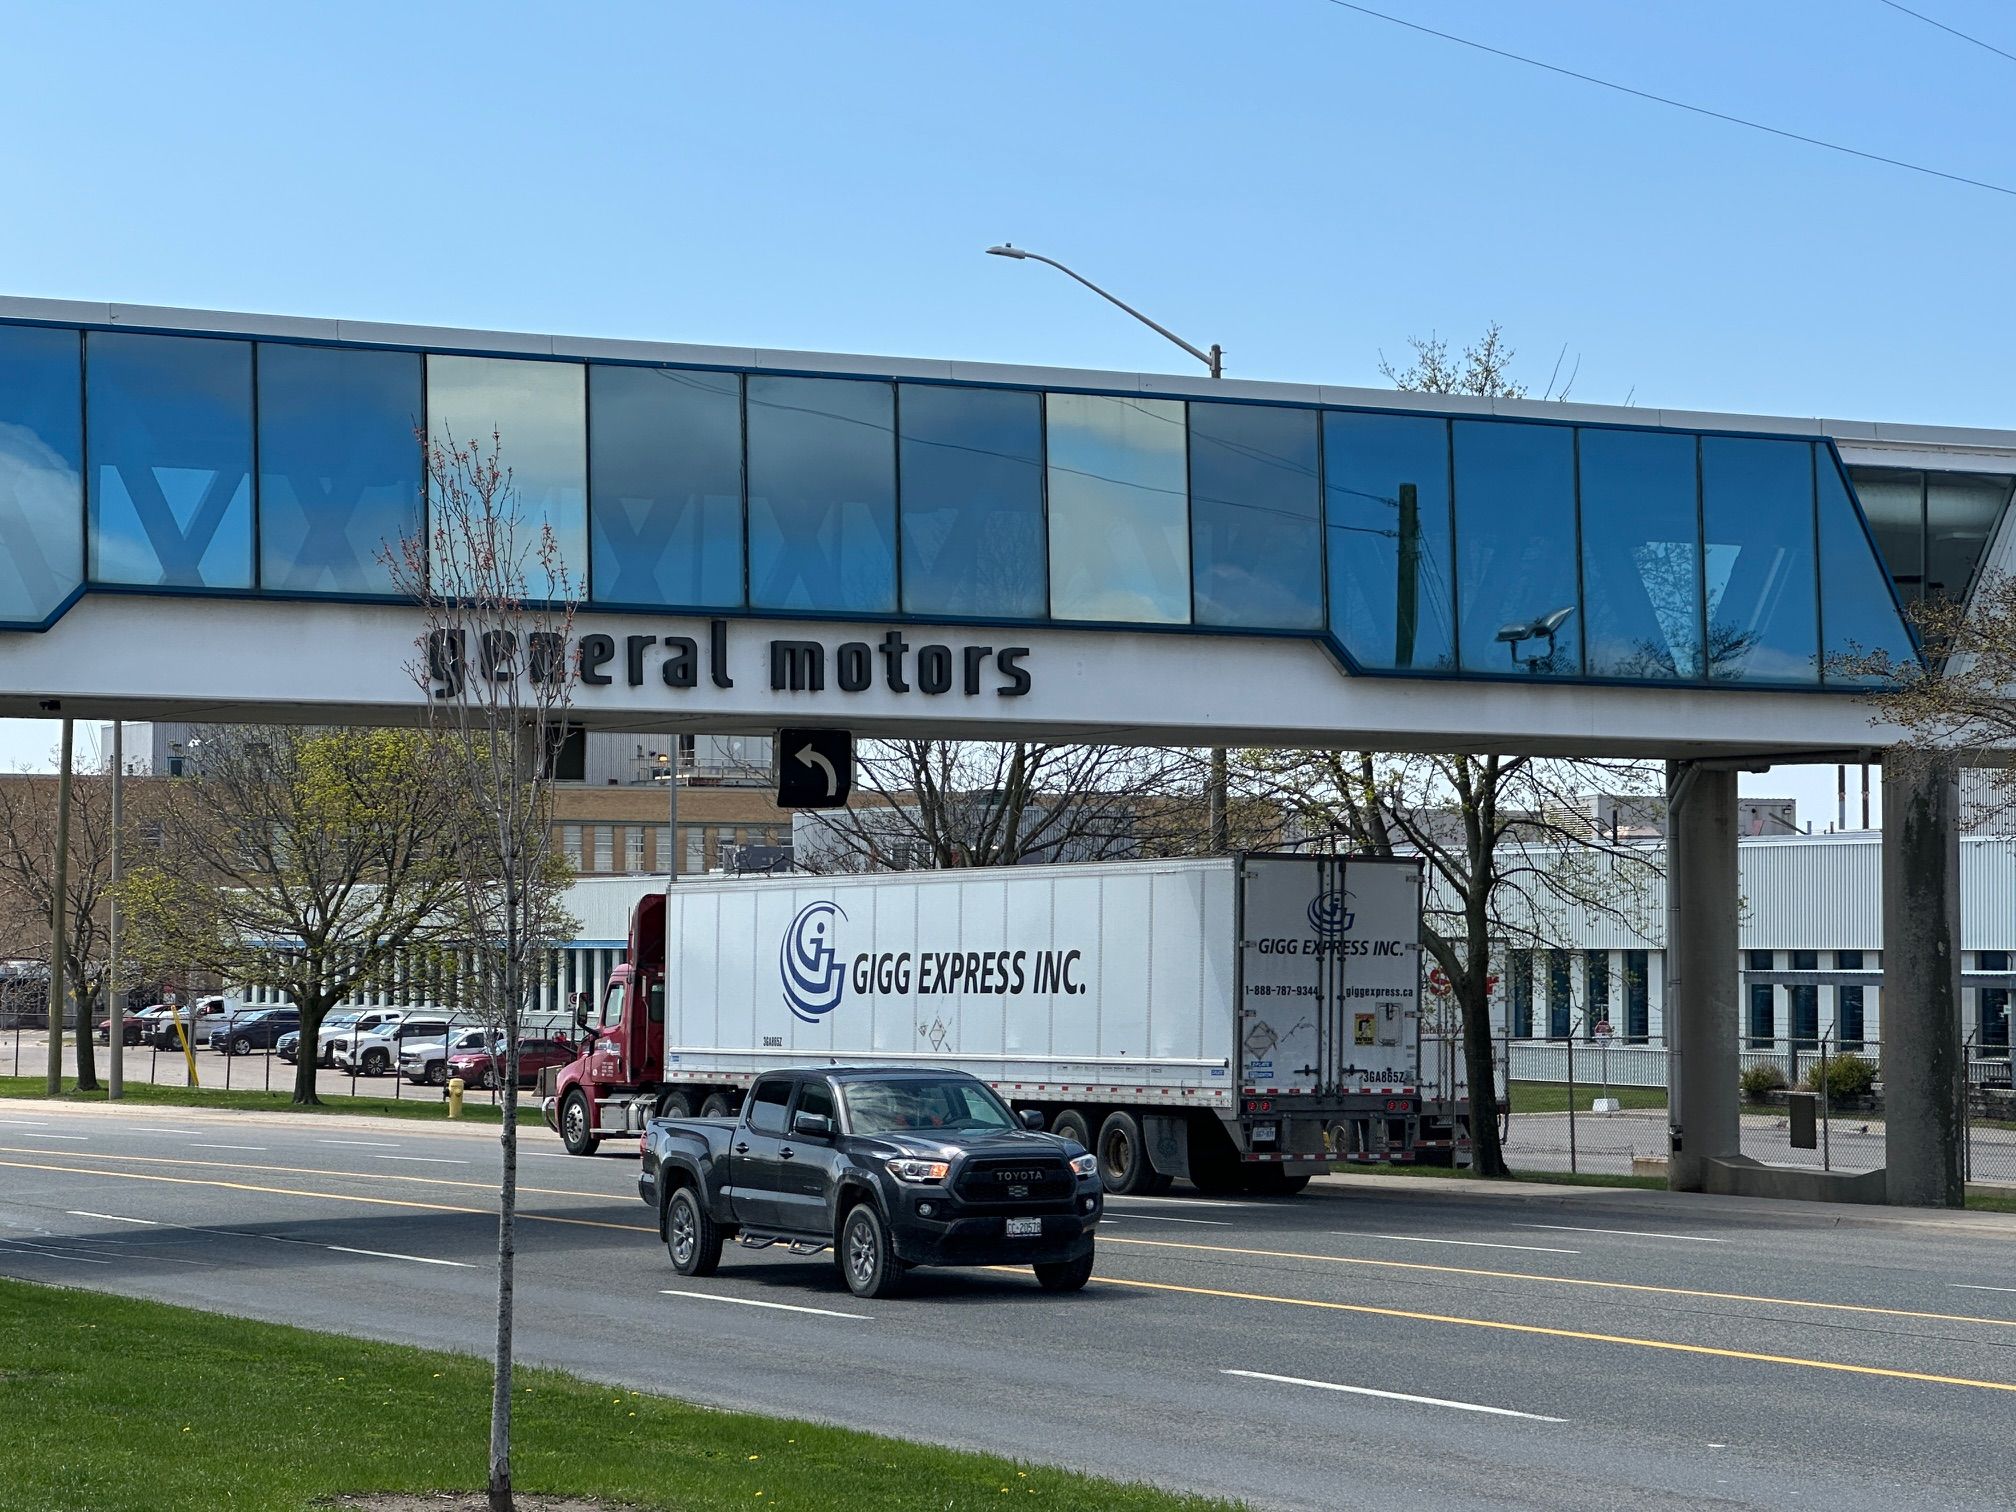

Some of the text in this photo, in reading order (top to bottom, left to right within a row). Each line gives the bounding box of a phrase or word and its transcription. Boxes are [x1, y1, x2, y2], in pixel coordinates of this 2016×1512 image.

[430, 620, 1032, 698] general motors
[1258, 938, 1404, 957] GIGG EXPRESS INC.
[852, 949, 1086, 995] GIGG EXPRESS INC.
[1245, 985, 1319, 996] 1-888-787-9344
[1345, 986, 1414, 998] giggexpress.ca
[1363, 1070, 1405, 1083] 3GA865Z
[996, 1171, 1043, 1181] TOYOTA
